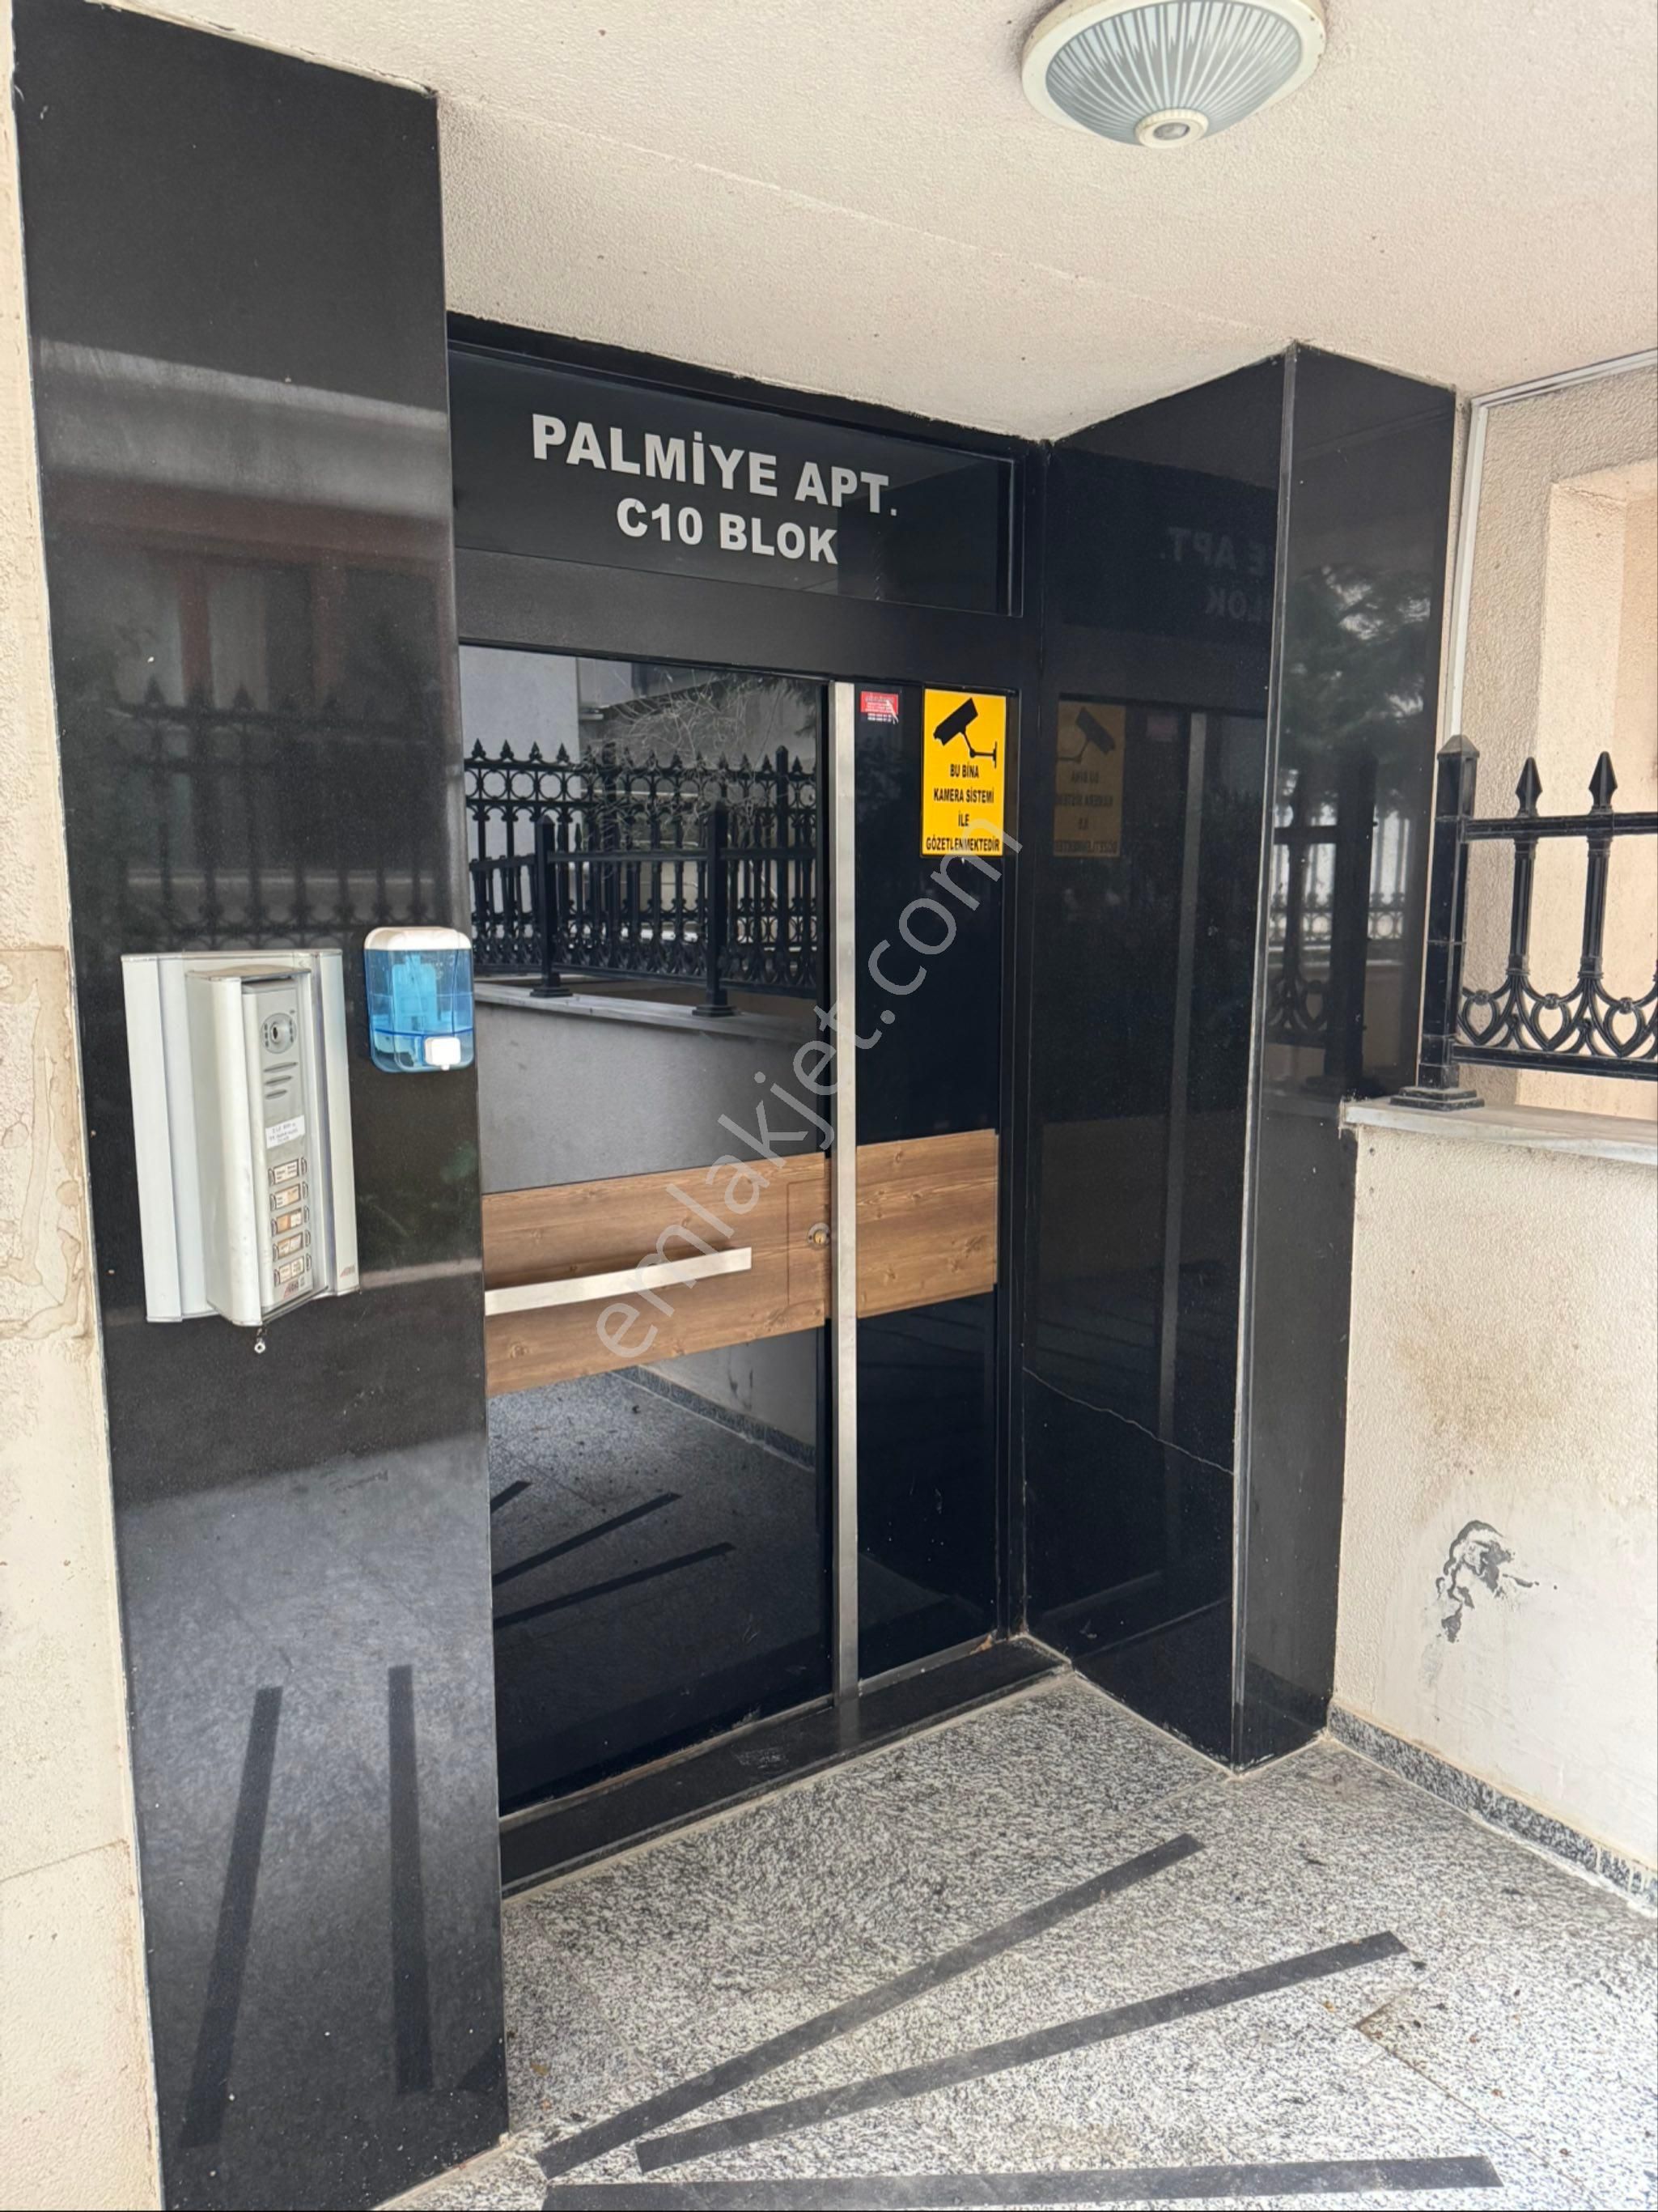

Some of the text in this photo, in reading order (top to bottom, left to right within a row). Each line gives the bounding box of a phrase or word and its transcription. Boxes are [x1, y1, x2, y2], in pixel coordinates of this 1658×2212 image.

[532, 414, 897, 517] PALMİYE APT.
[616, 497, 839, 566] C10 BLOK
[949, 762, 979, 778] BU BİNA
[933, 786, 994, 804] KAMERA SİSTEMİ
[958, 809, 969, 827] İLE
